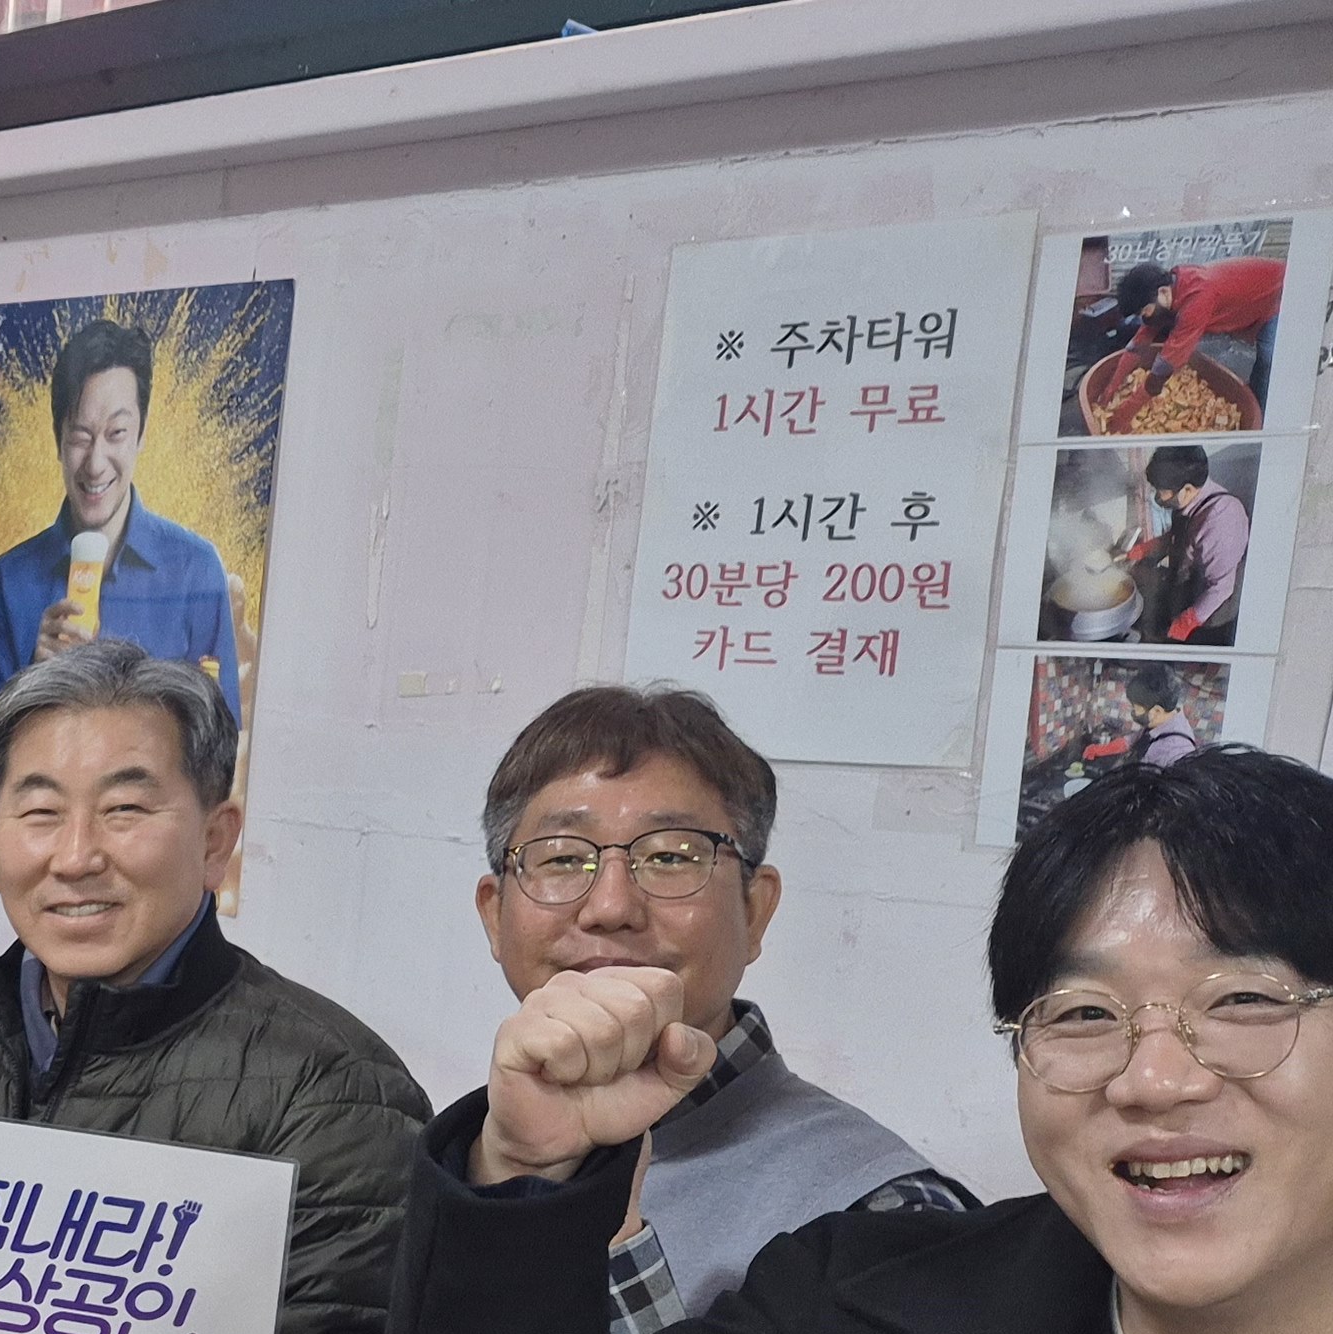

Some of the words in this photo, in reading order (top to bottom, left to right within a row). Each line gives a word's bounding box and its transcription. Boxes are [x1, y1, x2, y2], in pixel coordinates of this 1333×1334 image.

[769, 308, 960, 369] 주차타워
[712, 387, 825, 438] 1시간
[848, 383, 947, 433] 무료
[750, 492, 866, 543] 1시간
[891, 491, 941, 540] 후
[661, 560, 799, 611] 30분당
[822, 561, 952, 611] 200원
[692, 625, 778, 672] 카드
[806, 629, 900, 678] 결재
